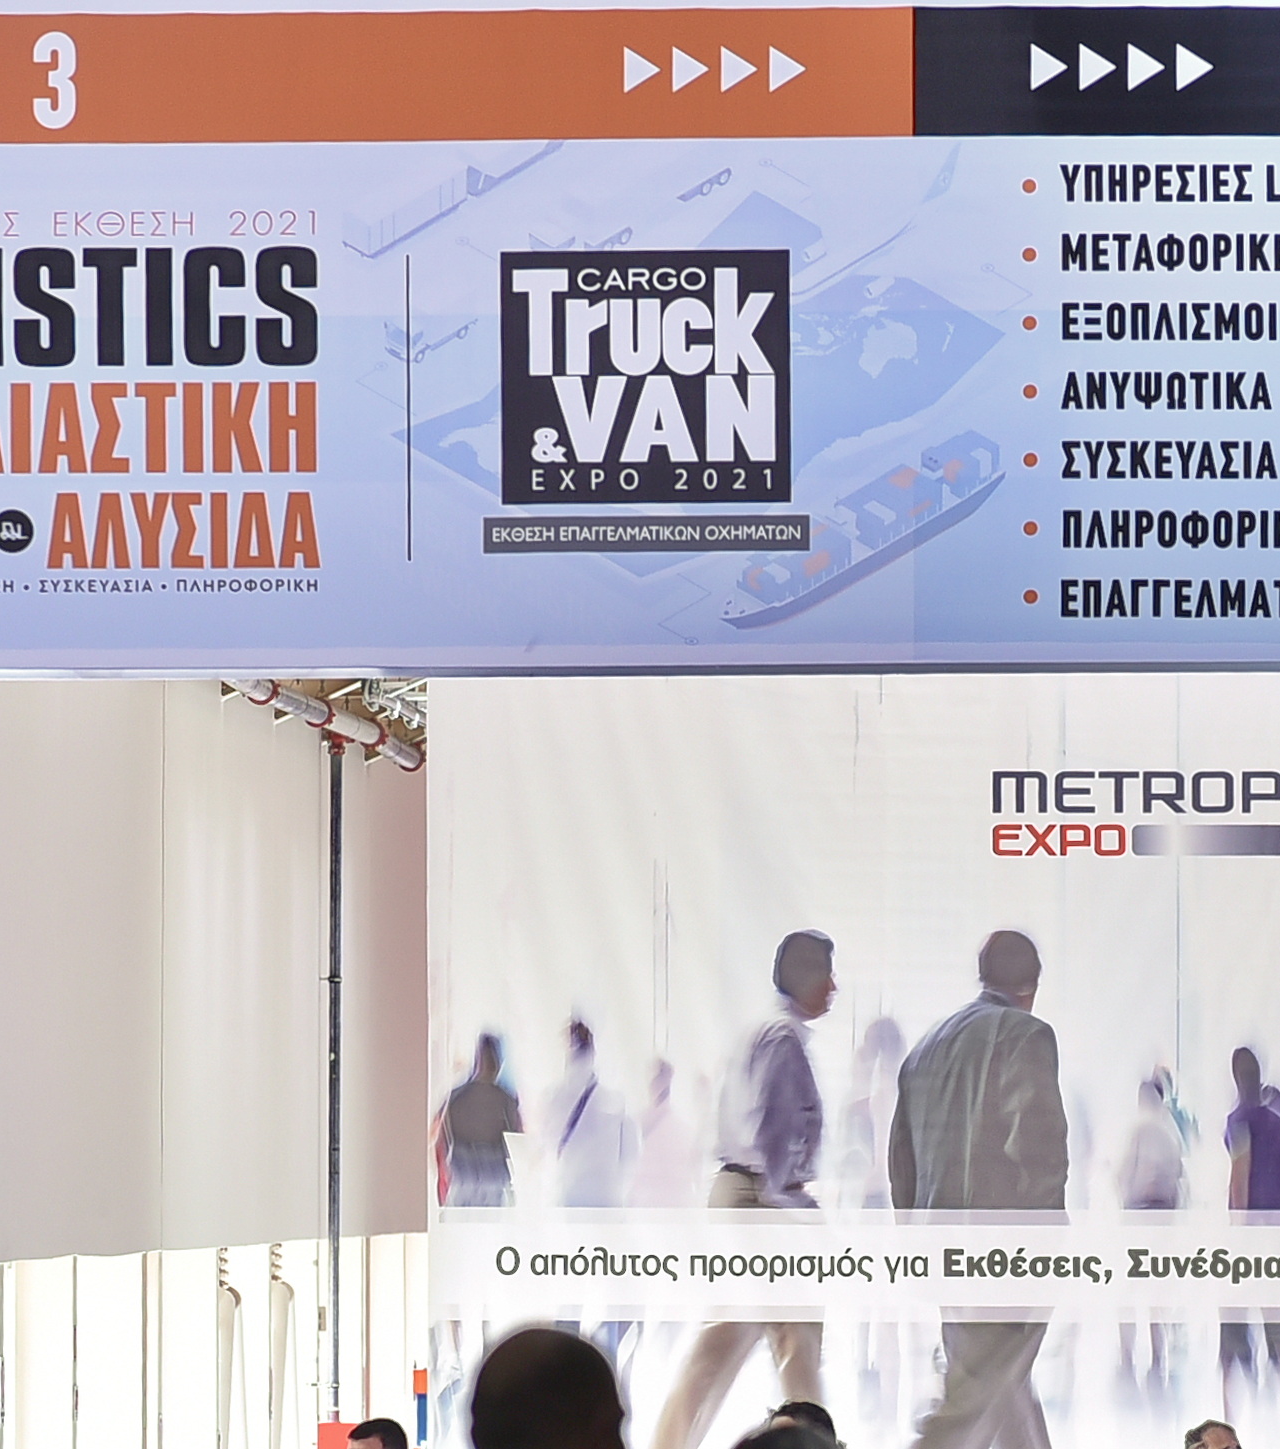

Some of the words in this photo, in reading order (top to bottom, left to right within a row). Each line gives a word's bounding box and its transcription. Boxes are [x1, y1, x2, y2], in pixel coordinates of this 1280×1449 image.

[32, 31, 78, 129] 3
[1059, 163, 1253, 203] ΥΠΗΡΕΣΙΕΣ
[52, 211, 195, 237] ΕΚΘΕΣΗ
[229, 209, 318, 236] 2021
[577, 267, 707, 291] CARGO
[512, 267, 775, 376] Truck
[1061, 302, 1278, 341] ΕΞΟΠΛΙΣΜΟΙ
[1060, 371, 1272, 410] ΑΝΥΨΩΤΙΚΑ
[531, 428, 568, 462] &
[552, 375, 776, 462] VAN
[1060, 440, 1278, 479] ΣΥΣΚΕΥΑΣΙΑ
[531, 469, 640, 491] EXPO
[674, 469, 773, 490] 2021
[46, 492, 321, 569] ΑΛΥΣΙΔΑ
[491, 526, 555, 543] ΕΚΘΕΣΗ
[559, 525, 700, 542] ΕΠΑΓΓΕΛΜΑΤΙΚΩΝ
[704, 524, 801, 541] ΟΧΗΜΑΤΩΝ
[38, 579, 154, 594] ΣΥΣΚΕΥΑΣΙΑ
[175, 578, 319, 593] ΠΛΗΡΟΦΟΡΙΚΗ
[992, 825, 1126, 856] EXPO
[496, 1246, 520, 1276] Ο
[530, 1247, 679, 1280] απόλυτος
[689, 1248, 873, 1283] προορισμός
[884, 1254, 929, 1282] για
[943, 1248, 1113, 1284] Εκθέσεις,
